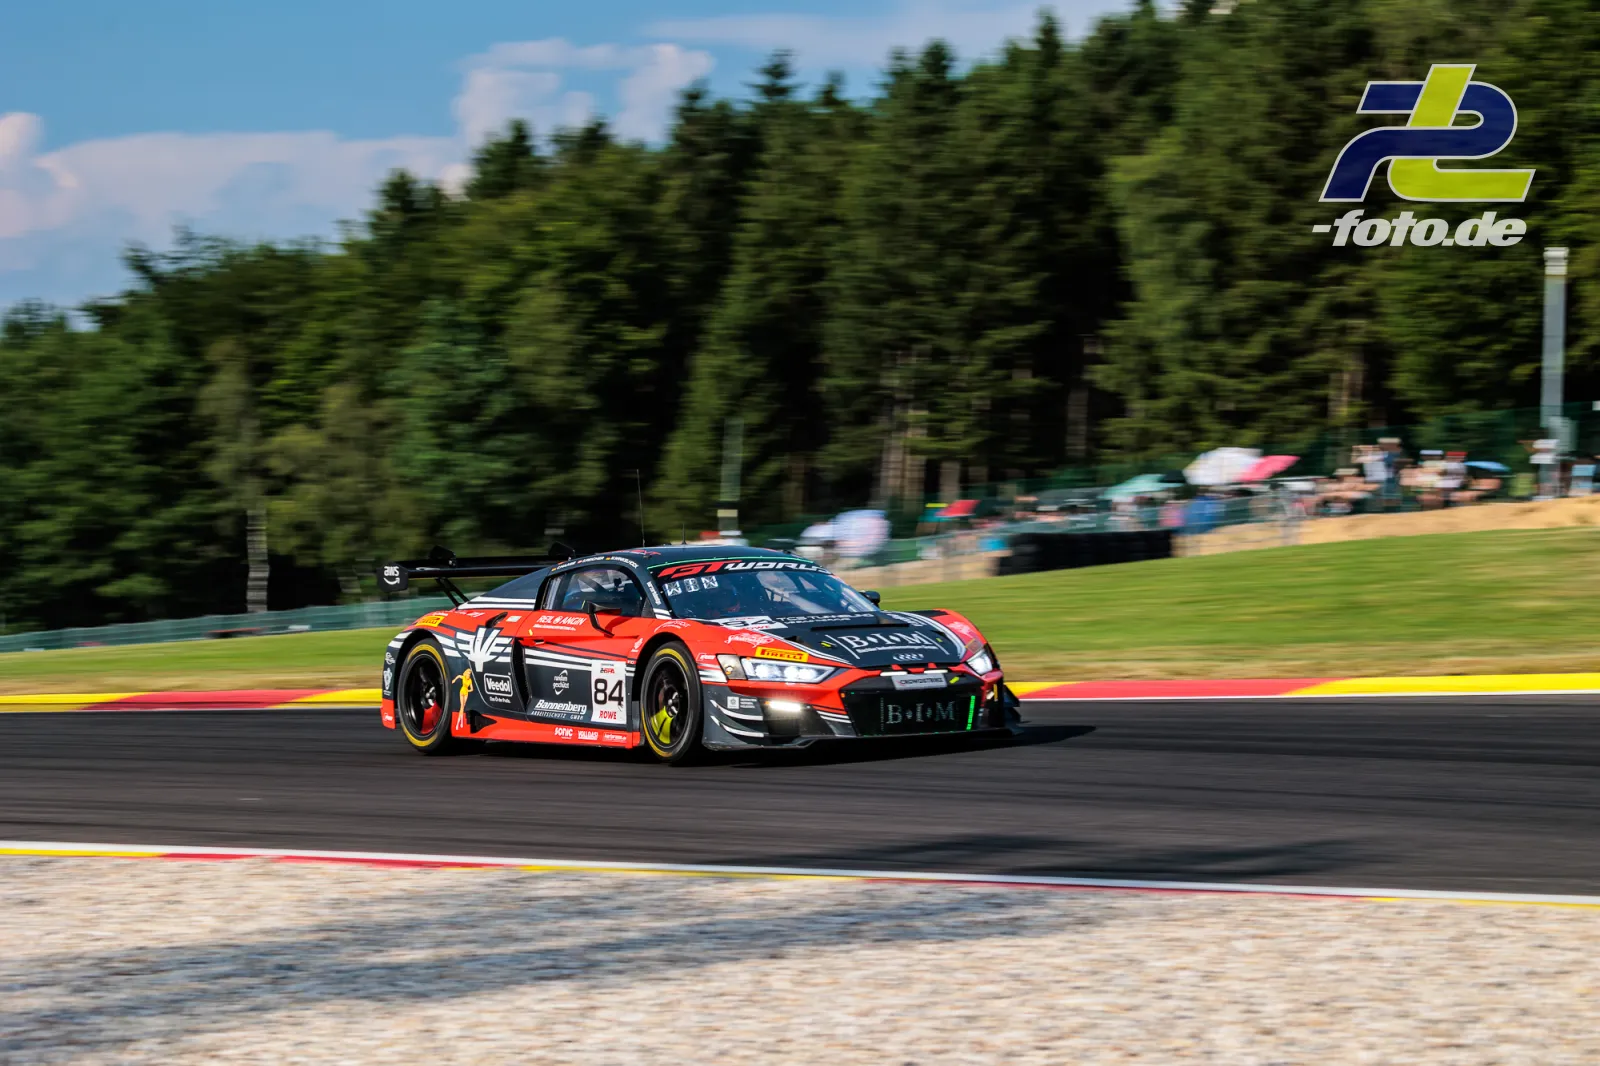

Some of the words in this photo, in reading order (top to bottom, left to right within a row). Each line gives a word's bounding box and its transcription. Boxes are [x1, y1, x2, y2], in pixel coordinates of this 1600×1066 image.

[383, 566, 399, 576] aws
[664, 575, 719, 597] WIN
[760, 649, 806, 660] PIRELLI
[486, 677, 511, 693] Veedol
[594, 678, 624, 706] 84
[535, 699, 587, 715] Bannenberg
[599, 710, 617, 719] ROWE
